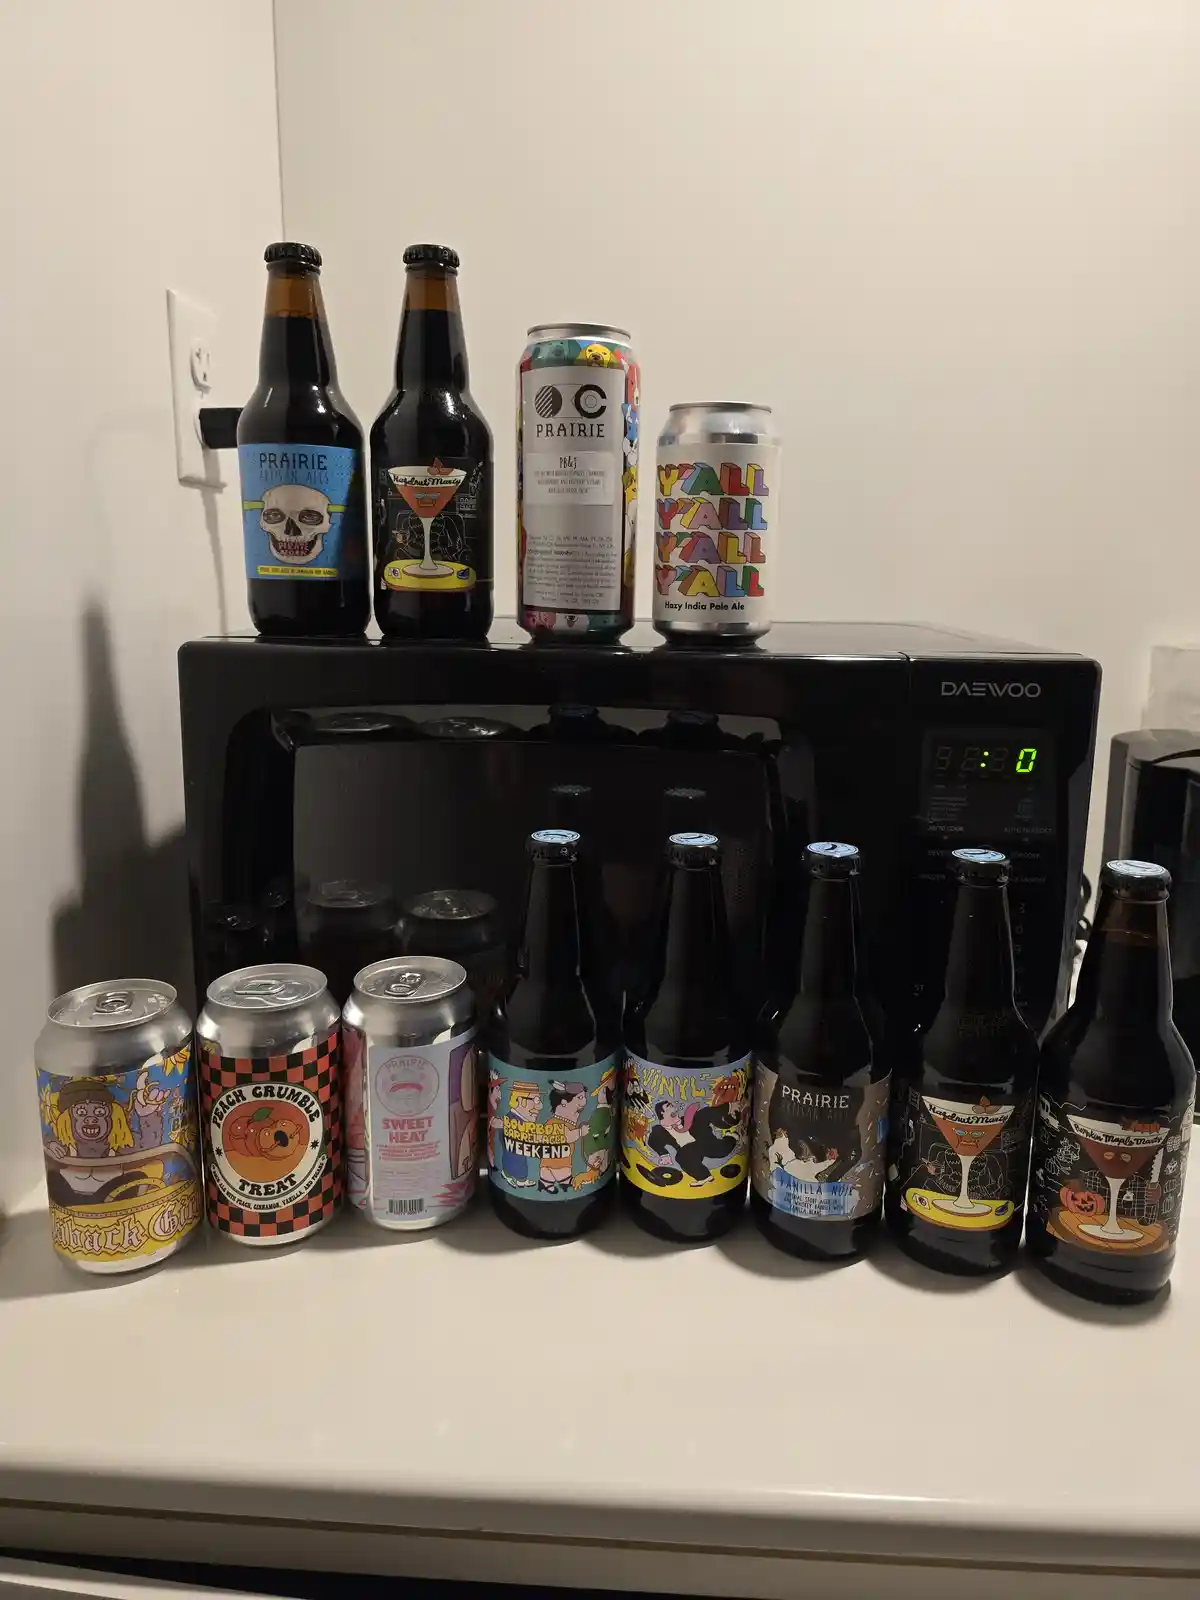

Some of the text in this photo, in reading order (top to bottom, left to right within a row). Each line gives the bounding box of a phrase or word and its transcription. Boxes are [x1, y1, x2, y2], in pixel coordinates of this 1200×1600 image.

[536, 423, 605, 438] PRAIRIE
[259, 452, 328, 471] PRAIRIE
[664, 601, 745, 611] Hazy India Pale Ale
[941, 681, 1042, 698] DAEWOO
[384, 1058, 429, 1072] PRAIRIE
[642, 1068, 706, 1099] VINYL
[781, 1085, 850, 1109] PRAIRIE
[211, 1085, 321, 1129] PEACH CRUMBLE
[382, 1116, 434, 1130] SWEET
[503, 1115, 566, 1136] BOURBON
[388, 1130, 429, 1143] HEAT
[503, 1126, 567, 1145] BARREL AGED
[1102, 1134, 1134, 1147] Maple
[503, 1137, 571, 1160] WEEKEND
[239, 1173, 298, 1197] TREAT
[779, 1174, 823, 1195] VANILLA
